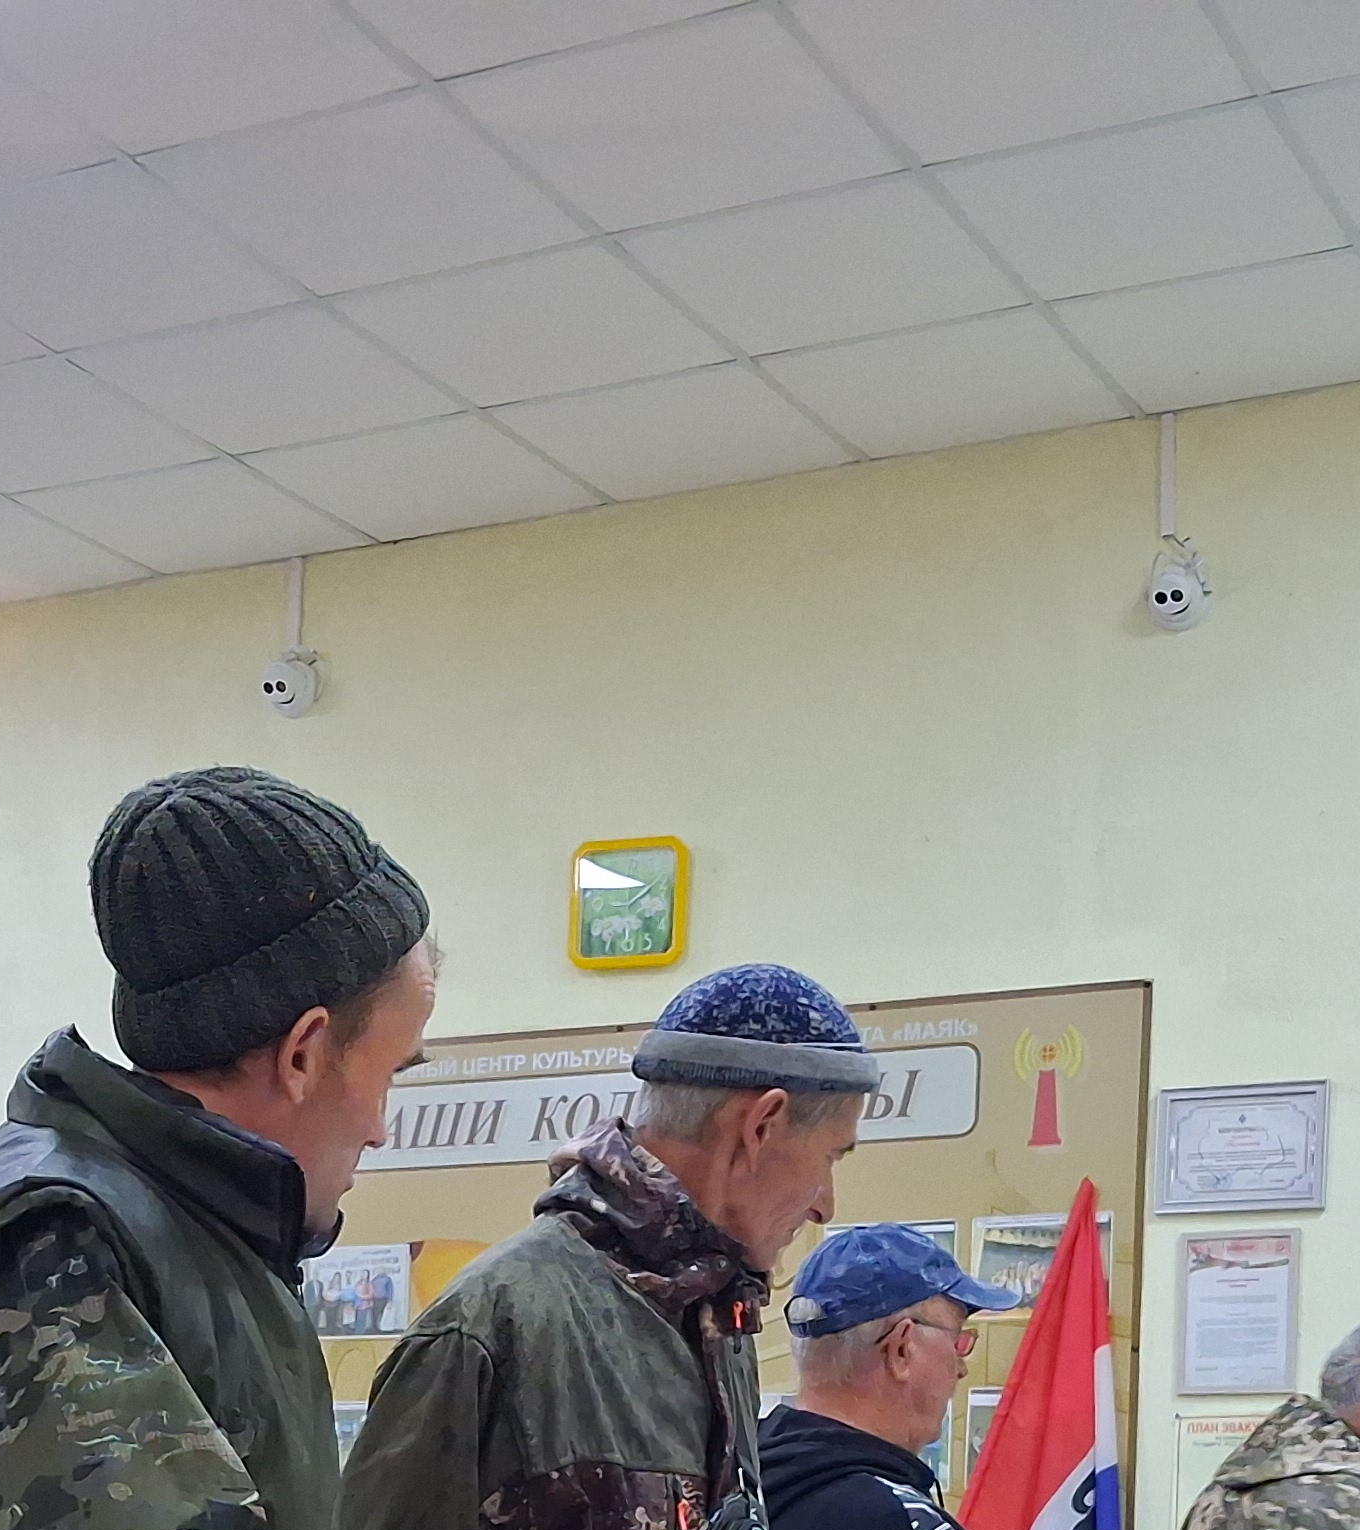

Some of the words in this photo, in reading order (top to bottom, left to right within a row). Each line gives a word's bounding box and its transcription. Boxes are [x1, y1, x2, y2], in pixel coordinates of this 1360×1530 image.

[463, 1057, 526, 1076] ЦЕНТР
[892, 1018, 979, 1042] «МАЯК»
[386, 1100, 508, 1151] АШИ
[860, 1069, 923, 1121] Ы
[1187, 1422, 1219, 1434] ПЛАН
[1221, 1421, 1259, 1433] ЭВАКУ
